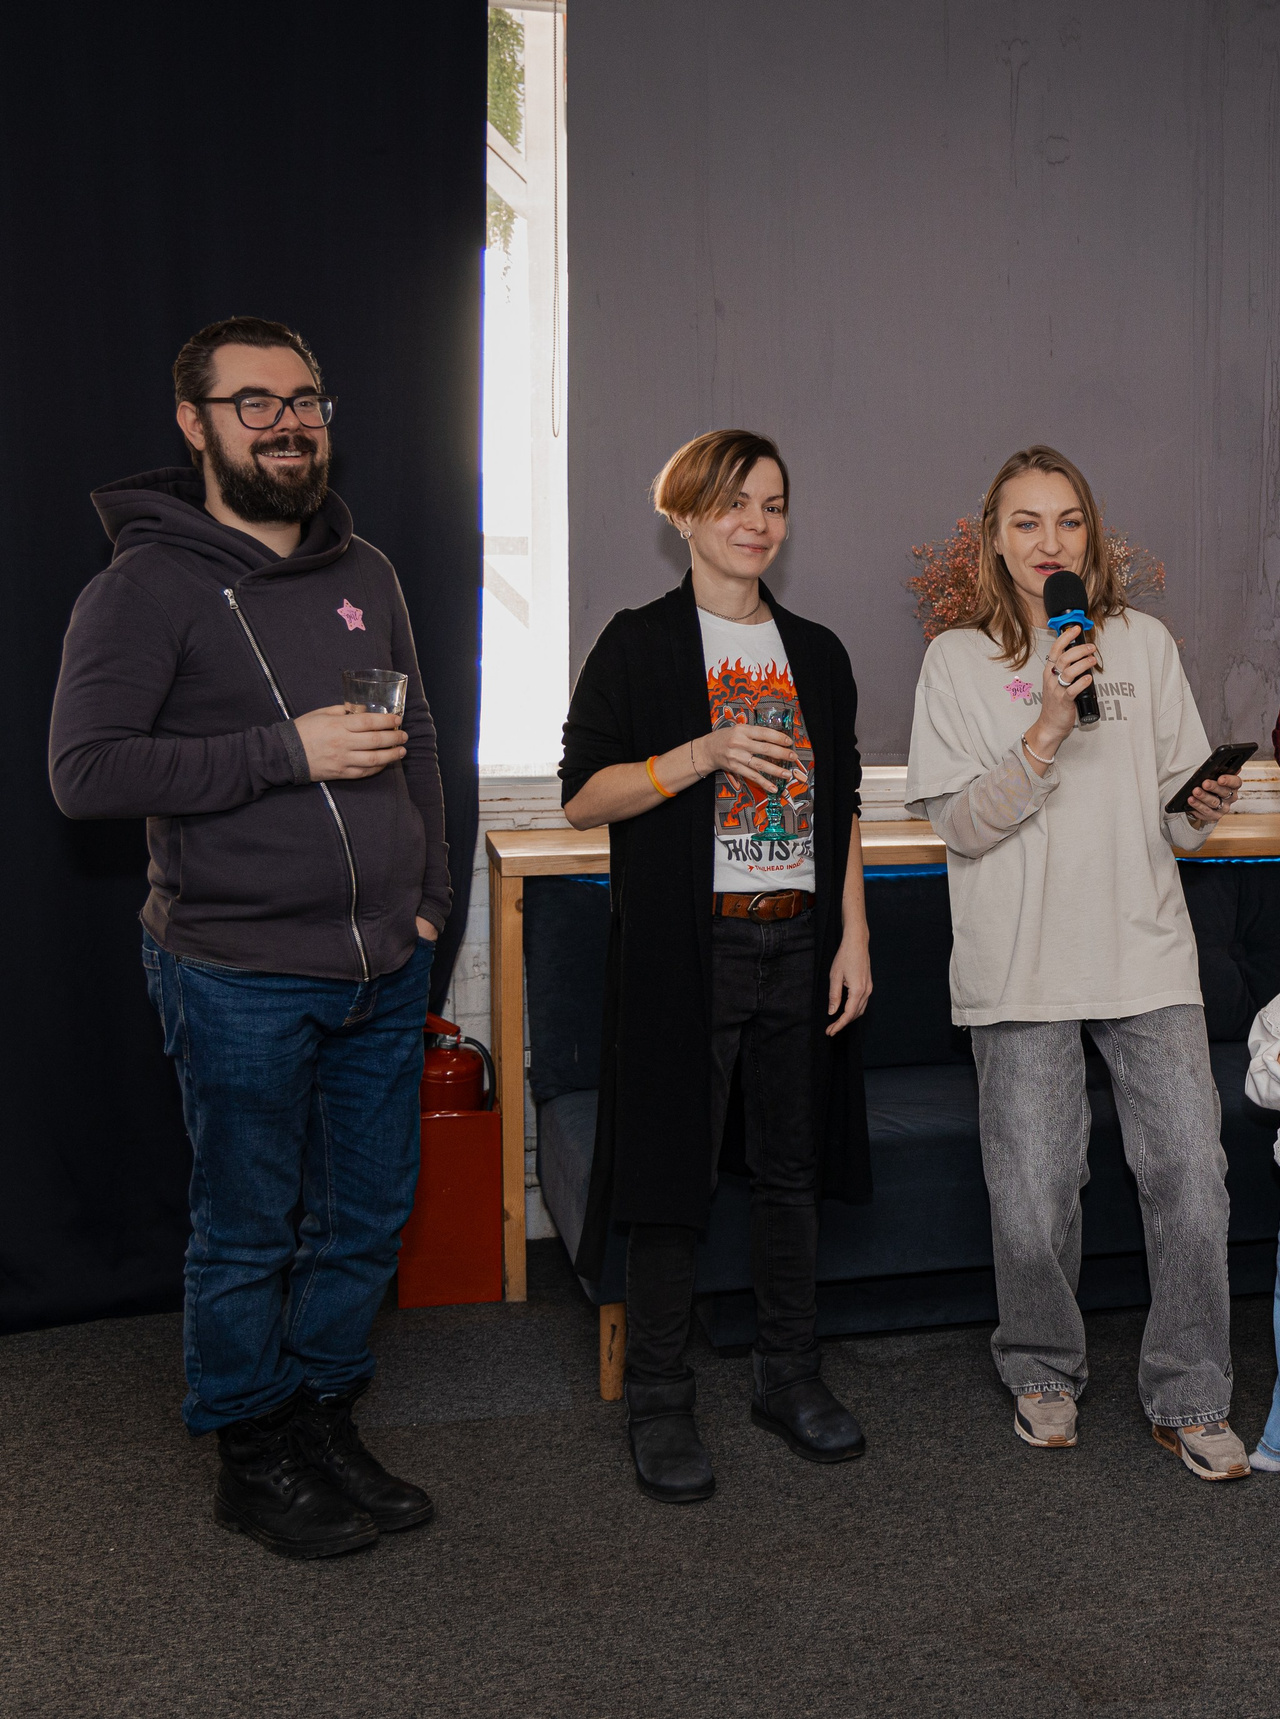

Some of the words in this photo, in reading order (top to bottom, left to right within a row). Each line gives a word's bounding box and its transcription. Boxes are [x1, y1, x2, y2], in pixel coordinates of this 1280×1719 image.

[1011, 684, 1027, 696] girl
[720, 838, 762, 862] THIS
[768, 840, 790, 862] IS
